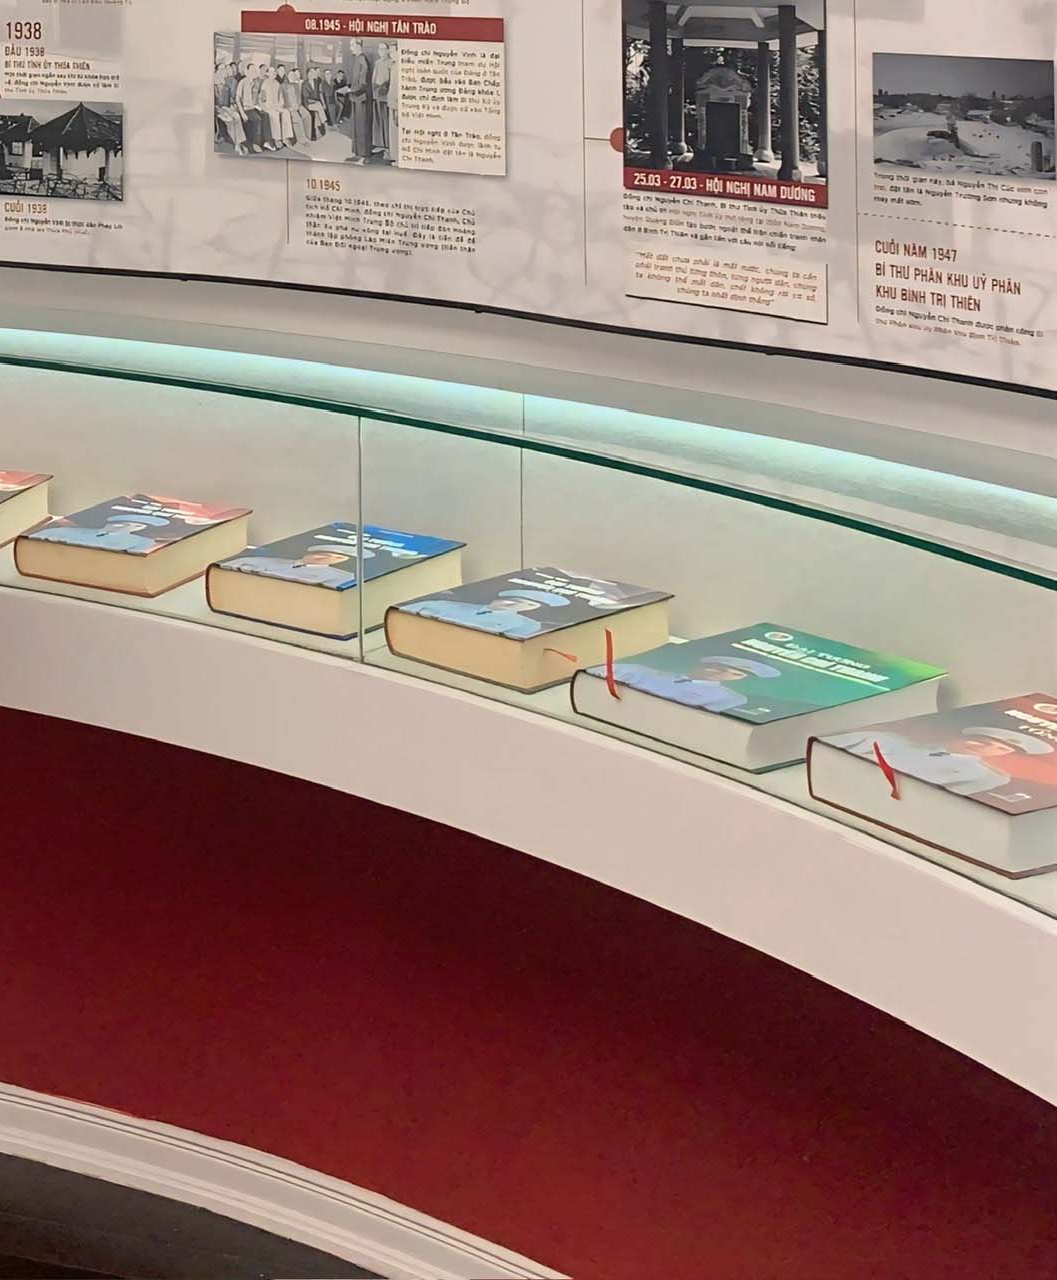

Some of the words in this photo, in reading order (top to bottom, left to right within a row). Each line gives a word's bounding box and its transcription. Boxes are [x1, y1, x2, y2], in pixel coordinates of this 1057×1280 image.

[6, 22, 42, 40] 1938
[304, 18, 341, 31] 08.1945
[349, 18, 364, 34] HỘI
[367, 20, 389, 35] NGHỊ
[392, 19, 410, 34] TÂN
[412, 20, 437, 35] TRÀO
[25, 46, 45, 57] 1938
[306, 178, 341, 192] 10.1945
[633, 172, 661, 187] 25.03
[669, 176, 698, 190] 27.03
[706, 178, 724, 195] HỘI
[726, 180, 751, 198] NGHỊ
[754, 182, 778, 198] NAM
[780, 185, 816, 202] DƯƠNG
[28, 203, 47, 214] 1938
[874, 238, 900, 255] CUỐI
[904, 243, 927, 259] NĂM
[932, 248, 958, 262] 1947
[875, 261, 886, 277] BÍ
[889, 264, 910, 280] THƯ
[914, 267, 943, 284] PHÂN
[947, 272, 968, 288] KHU
[991, 278, 1021, 296] PHÂN
[876, 284, 897, 300] KHU
[901, 287, 926, 304] BÌNH
[930, 292, 947, 309] TRỊ
[950, 295, 981, 312] THIÊN
